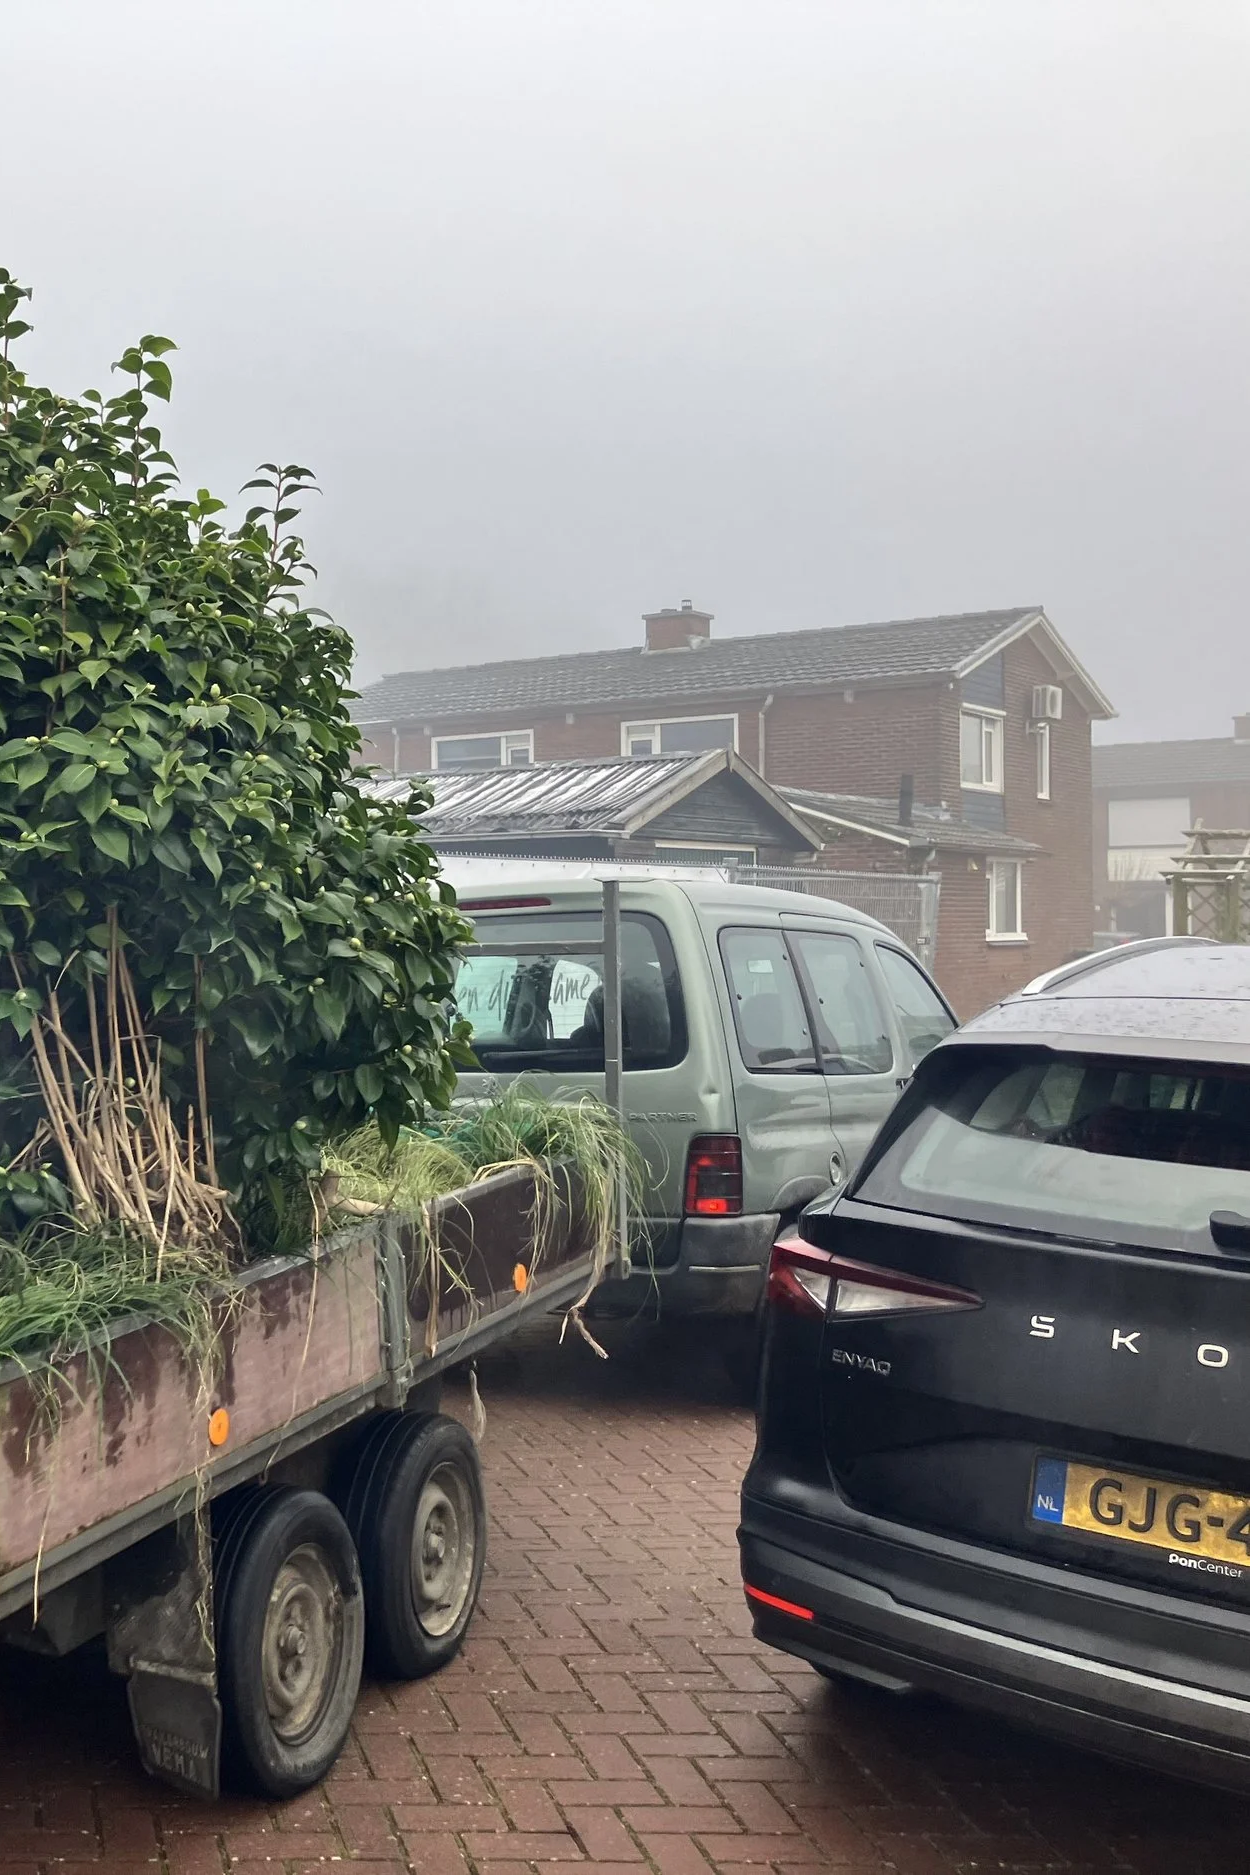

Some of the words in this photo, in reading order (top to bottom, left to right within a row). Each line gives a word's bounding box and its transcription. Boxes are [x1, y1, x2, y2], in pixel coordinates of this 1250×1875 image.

[629, 1111, 698, 1123] PARTNER
[831, 1348, 892, 1377] ENYAQ
[1037, 1494, 1059, 1512] NL
[1168, 1553, 1243, 1578] PonCenter
